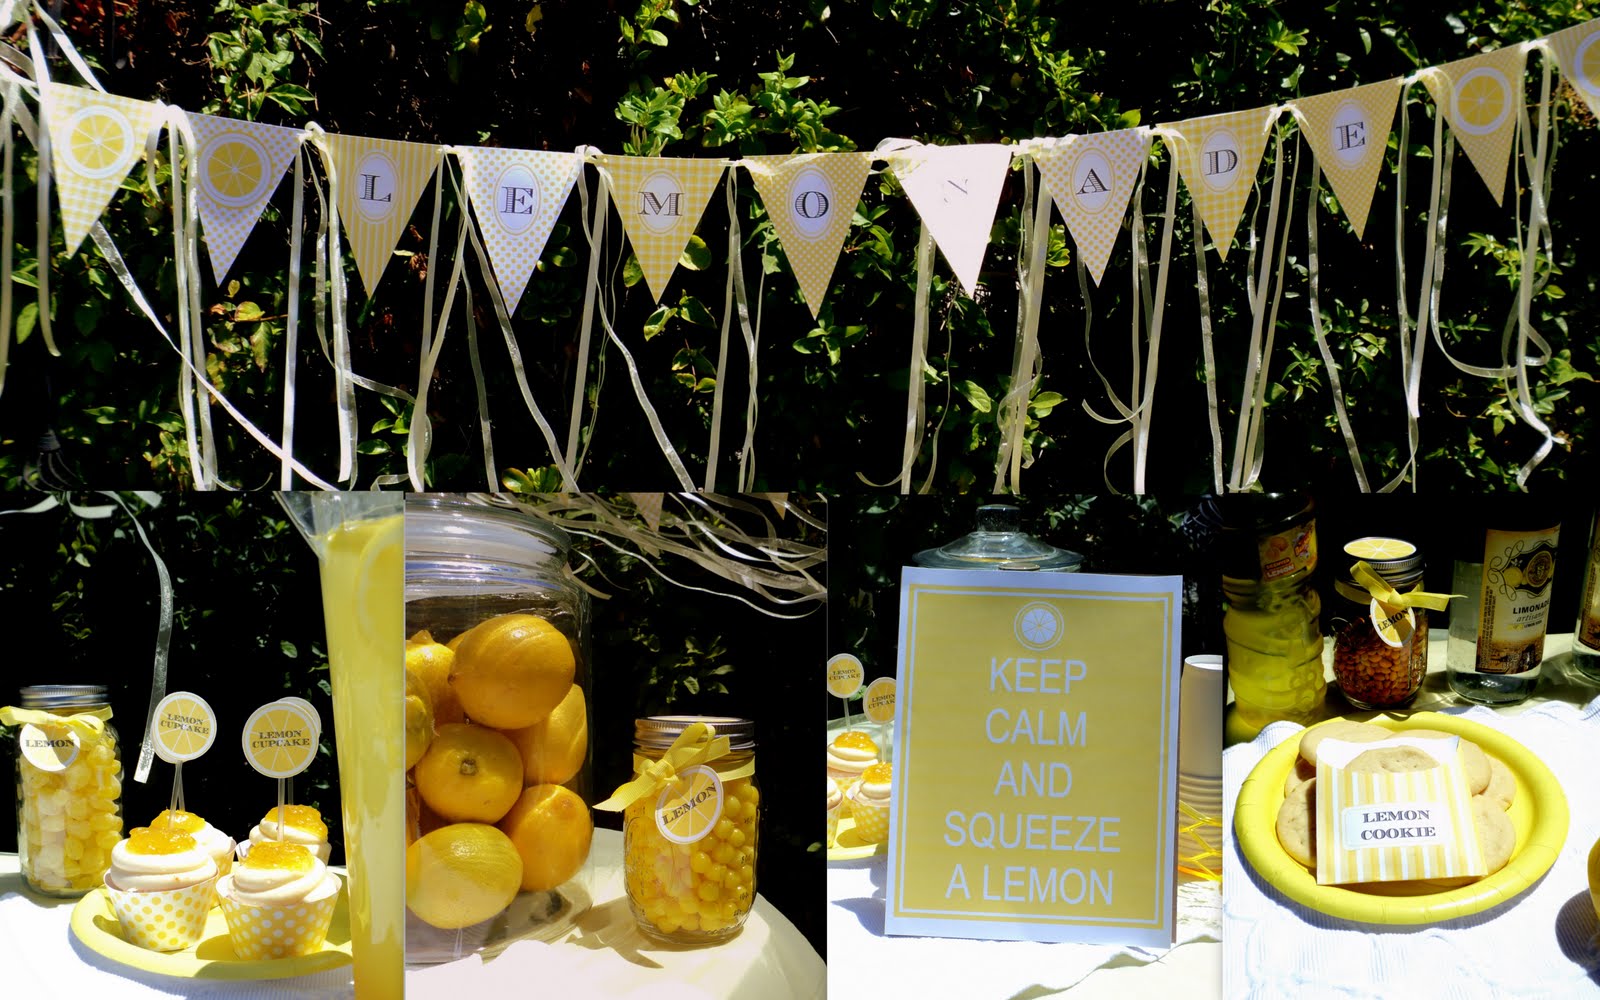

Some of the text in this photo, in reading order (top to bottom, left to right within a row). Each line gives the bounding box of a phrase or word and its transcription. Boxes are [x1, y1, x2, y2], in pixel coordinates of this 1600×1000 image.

[1377, 608, 1409, 632] LEMON
[828, 673, 861, 681] CUPCAKE
[989, 656, 1087, 695] KEEP
[868, 699, 896, 710] CUPCAK
[167, 713, 203, 726] LEMON
[985, 707, 1087, 747] CALM
[160, 720, 209, 735] CUPCAKE
[258, 730, 302, 740] LEMON
[25, 739, 75, 748] LEMON
[251, 738, 310, 749] CUPCAKE
[994, 760, 1073, 799] AND
[661, 782, 717, 826] LEMON
[1362, 810, 1430, 824] LEMON
[943, 810, 1121, 853] SQUEEZE
[1360, 826, 1436, 841] COOKIE
[945, 863, 1113, 906] A LEMON
